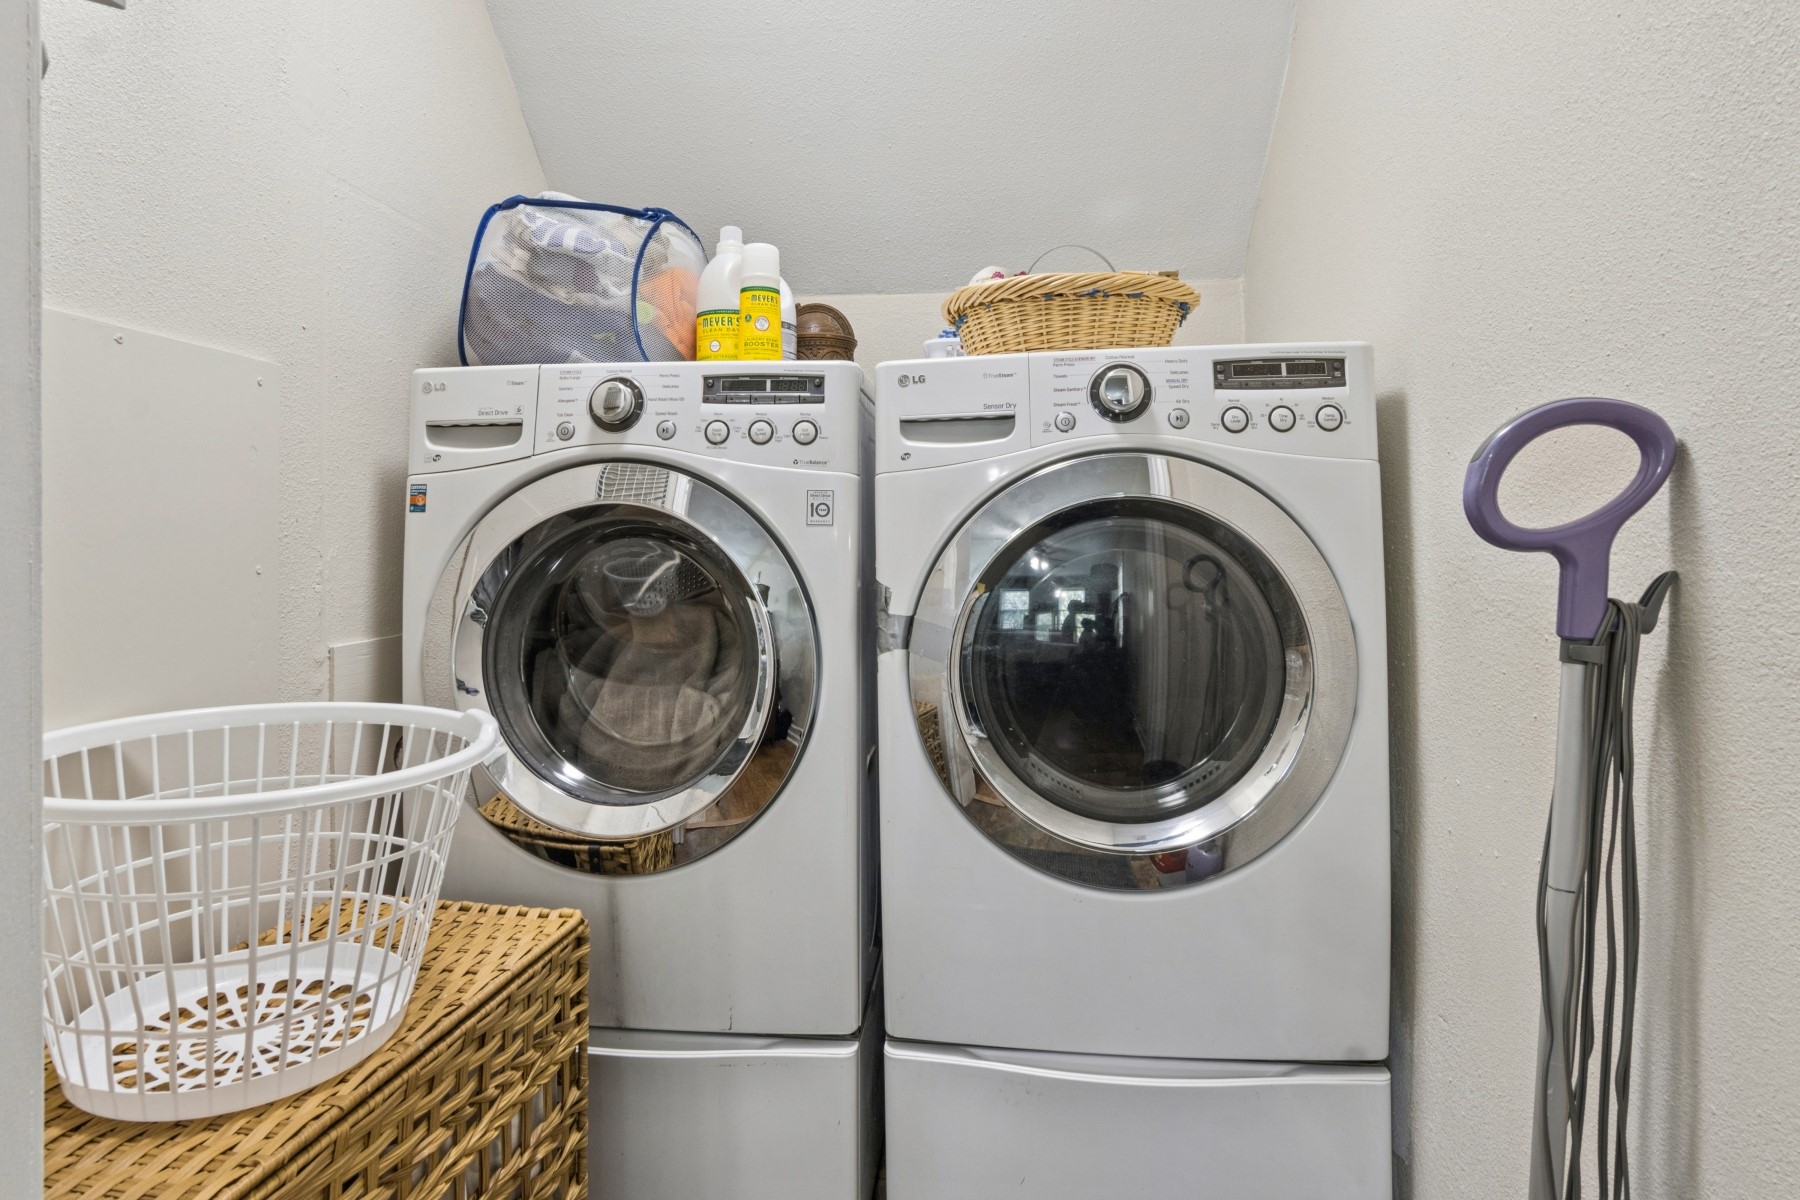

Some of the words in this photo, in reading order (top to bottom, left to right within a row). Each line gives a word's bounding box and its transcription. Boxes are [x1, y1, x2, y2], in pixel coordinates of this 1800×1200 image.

[751, 295, 778, 304] MEYER'S
[702, 316, 740, 328] MEYER'S
[912, 374, 926, 384] LG
[434, 382, 446, 392] LG
[810, 502, 830, 518] 10
